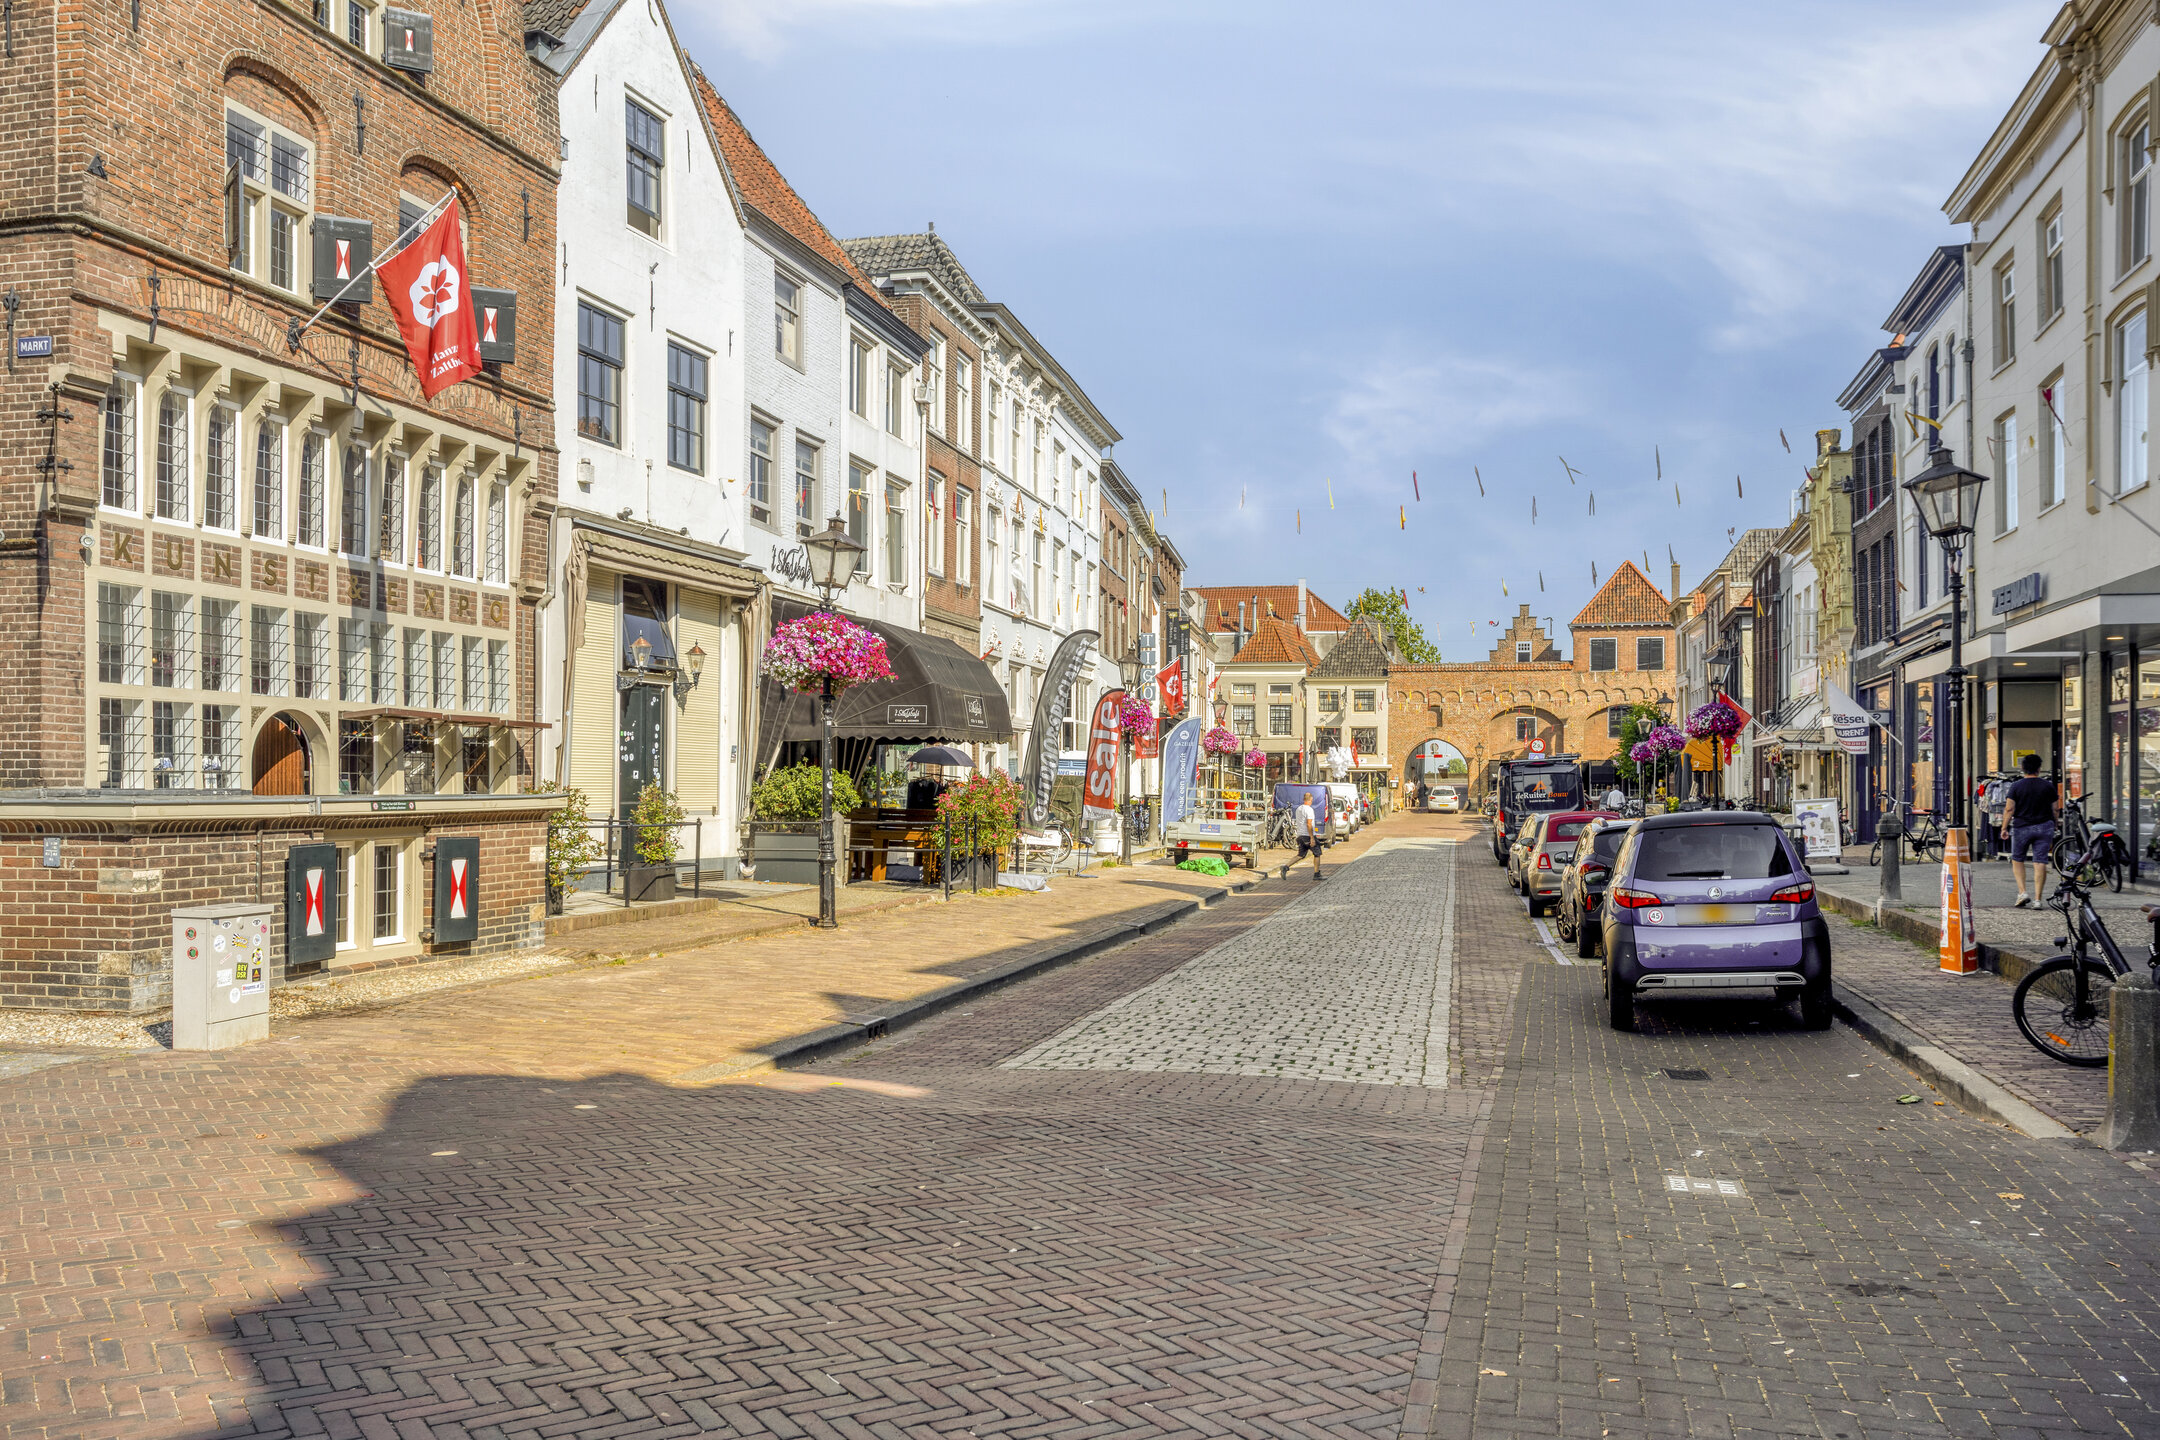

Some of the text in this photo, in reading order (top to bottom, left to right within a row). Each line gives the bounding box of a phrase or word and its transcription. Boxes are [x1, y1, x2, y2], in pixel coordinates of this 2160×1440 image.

[20, 340, 49, 352] MARKT
[113, 532, 504, 623] KUNST & EXPO
[1992, 572, 2041, 616] ZEEMAN
[1142, 632, 1154, 700] TIGO
[1090, 701, 1120, 799] sale
[1515, 792, 1546, 800] deRuiter
[1651, 912, 1660, 920] 45
[237, 964, 248, 972] BEV
[236, 971, 247, 979] DSR
